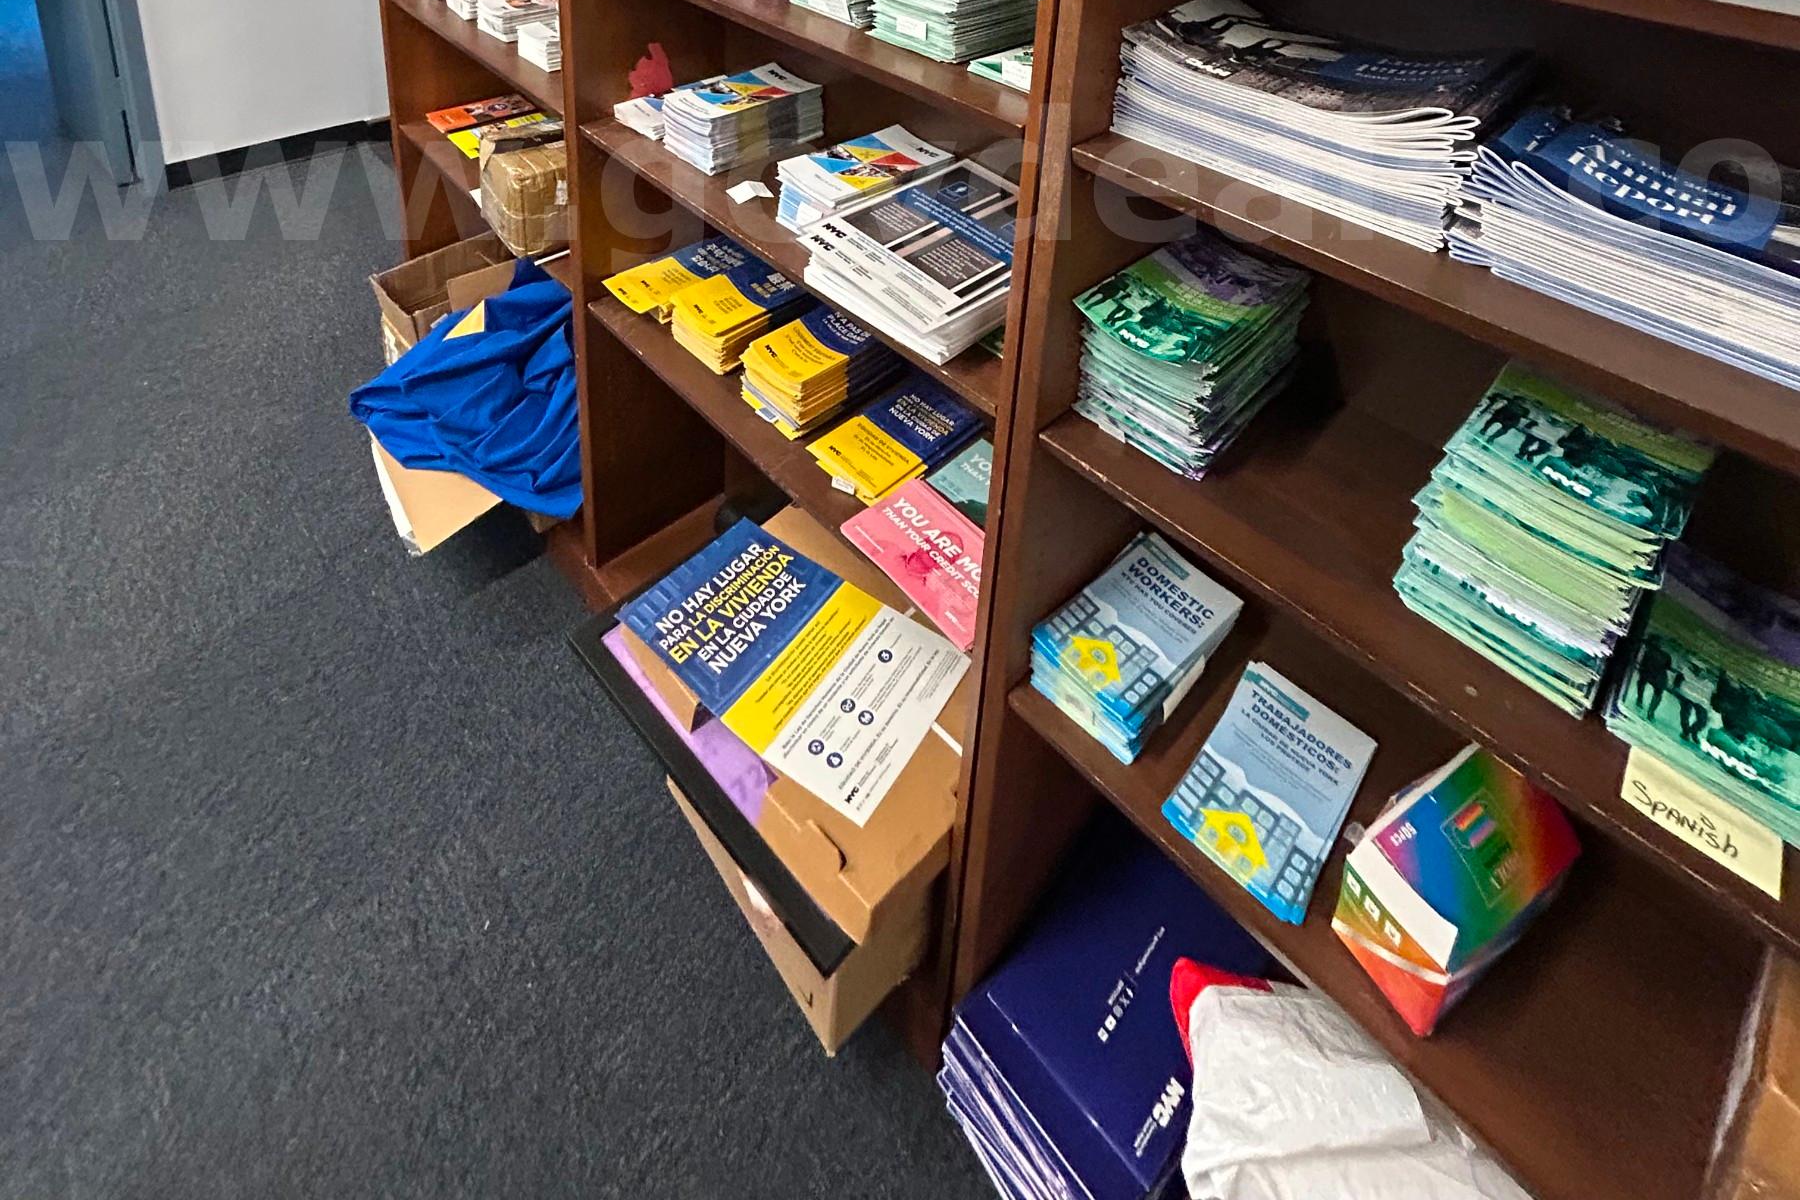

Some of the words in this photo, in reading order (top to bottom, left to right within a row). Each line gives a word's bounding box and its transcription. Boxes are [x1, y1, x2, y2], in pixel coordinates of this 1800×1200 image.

[768, 68, 788, 81] NYC
[915, 147, 940, 159] NYC
[1577, 144, 1736, 216] Annual
[1567, 151, 1715, 224] Report
[810, 234, 836, 252] NYC
[822, 223, 848, 240] NYC
[764, 344, 778, 358] NYC
[824, 312, 850, 334] PLACE
[888, 407, 914, 428] NUEVA
[914, 424, 936, 443] YORK
[882, 507, 909, 531] THAN
[905, 527, 931, 552] YOUR
[929, 550, 965, 580] CREDIT
[893, 497, 930, 528] YOU
[923, 528, 963, 559] ARE
[655, 610, 684, 634] NO
[681, 582, 715, 614] HAY
[713, 543, 765, 588] LUGAR
[659, 624, 693, 651] PARA
[688, 612, 707, 627] LA
[704, 544, 780, 614] DISCRIMINACIÓN
[668, 636, 700, 664] EN
[694, 618, 725, 641] LA
[718, 552, 794, 619] VIVIENDA
[697, 641, 719, 662] EN
[715, 627, 737, 645] LA
[733, 588, 776, 629] CIUDAD
[773, 571, 793, 590] DE
[1128, 563, 1205, 628] WORKERS:
[1137, 557, 1215, 620] DOMESTIC
[708, 621, 768, 675] NUEVA
[760, 578, 807, 620] YORK
[1252, 690, 1353, 770] TRABAJADORES
[844, 786, 860, 804] NYC
